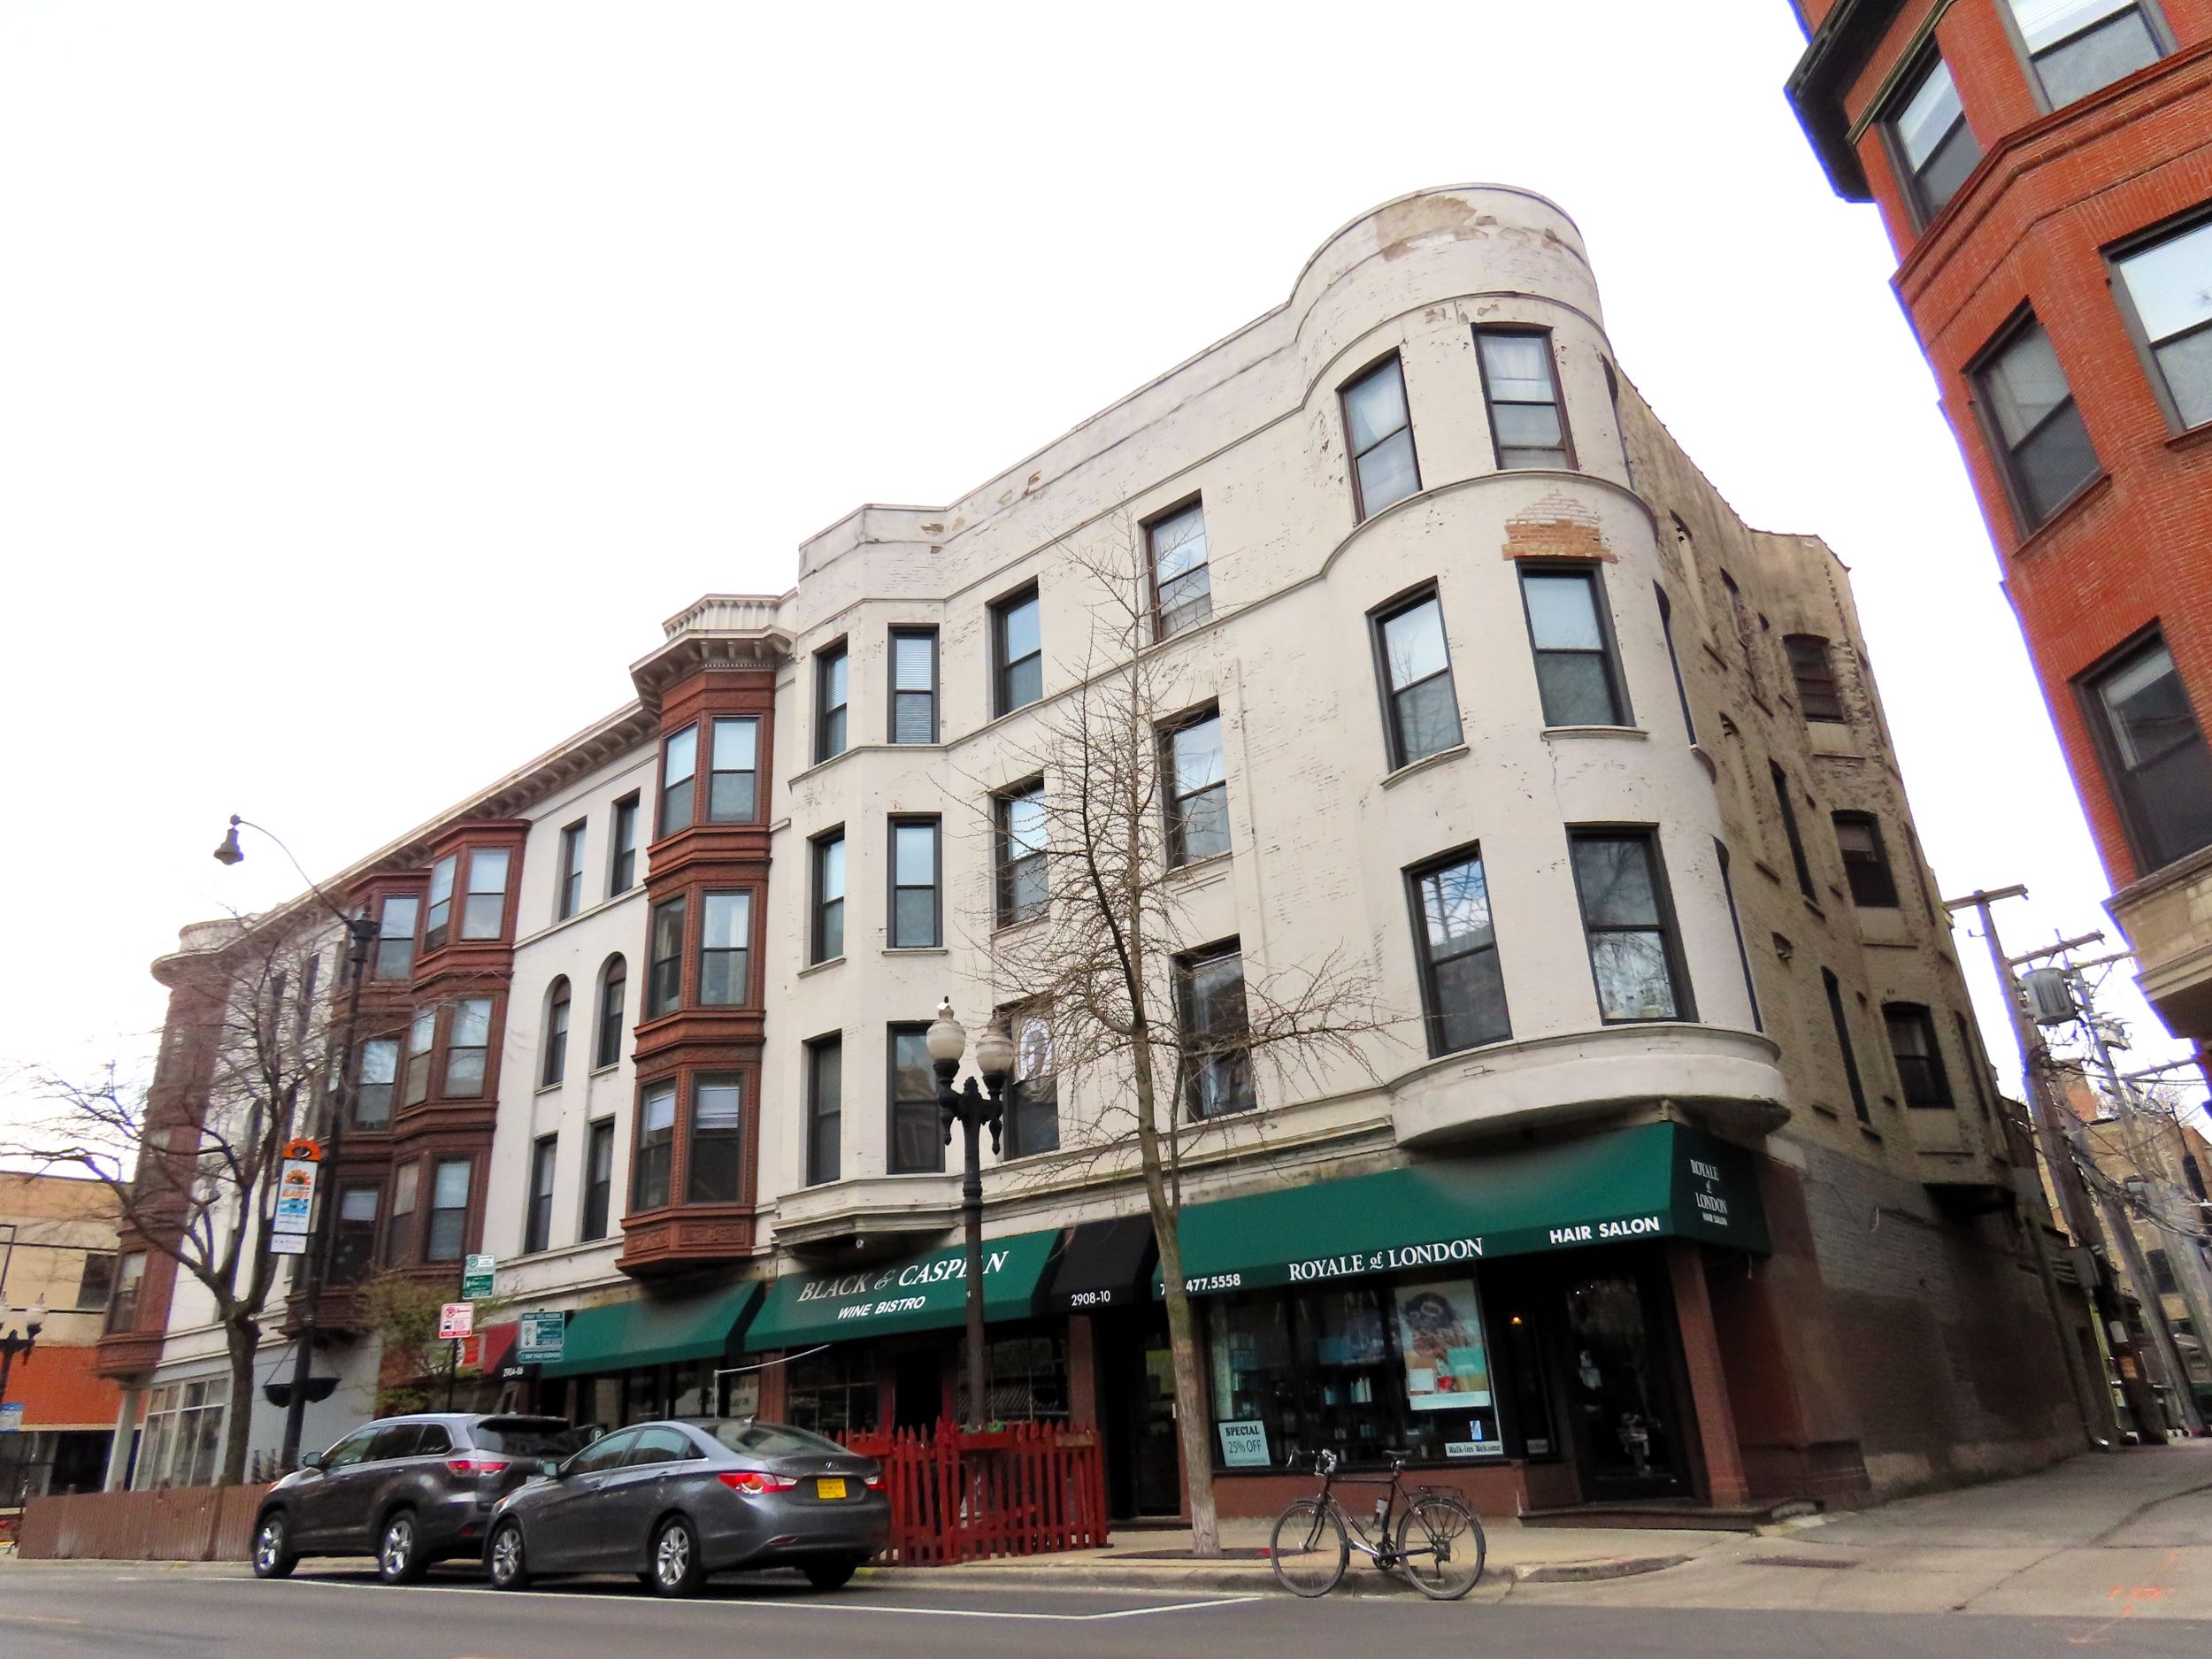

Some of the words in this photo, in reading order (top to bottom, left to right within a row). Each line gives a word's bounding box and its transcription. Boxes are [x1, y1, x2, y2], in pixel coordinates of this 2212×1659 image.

[1690, 1159, 1719, 1181] ROYALE
[1695, 1193, 1728, 1215] LONDON
[1549, 1225, 1593, 1244] HAIR
[1599, 1216, 1660, 1238] SALON
[1288, 1254, 1365, 1281] ROYALE
[1370, 1252, 1384, 1270] of
[1387, 1237, 1483, 1268] LONDON
[797, 1273, 872, 1302] BLACK
[874, 1269, 895, 1290] &
[898, 1250, 1010, 1286] CASPIN
[837, 1303, 872, 1319] WINE
[874, 1295, 926, 1314] BISTRO
[1071, 1290, 1110, 1306] 2908-10
[1225, 1425, 1260, 1437] SPECIAL
[1228, 1441, 1245, 1454] 25%
[1246, 1440, 1261, 1453] OFF
